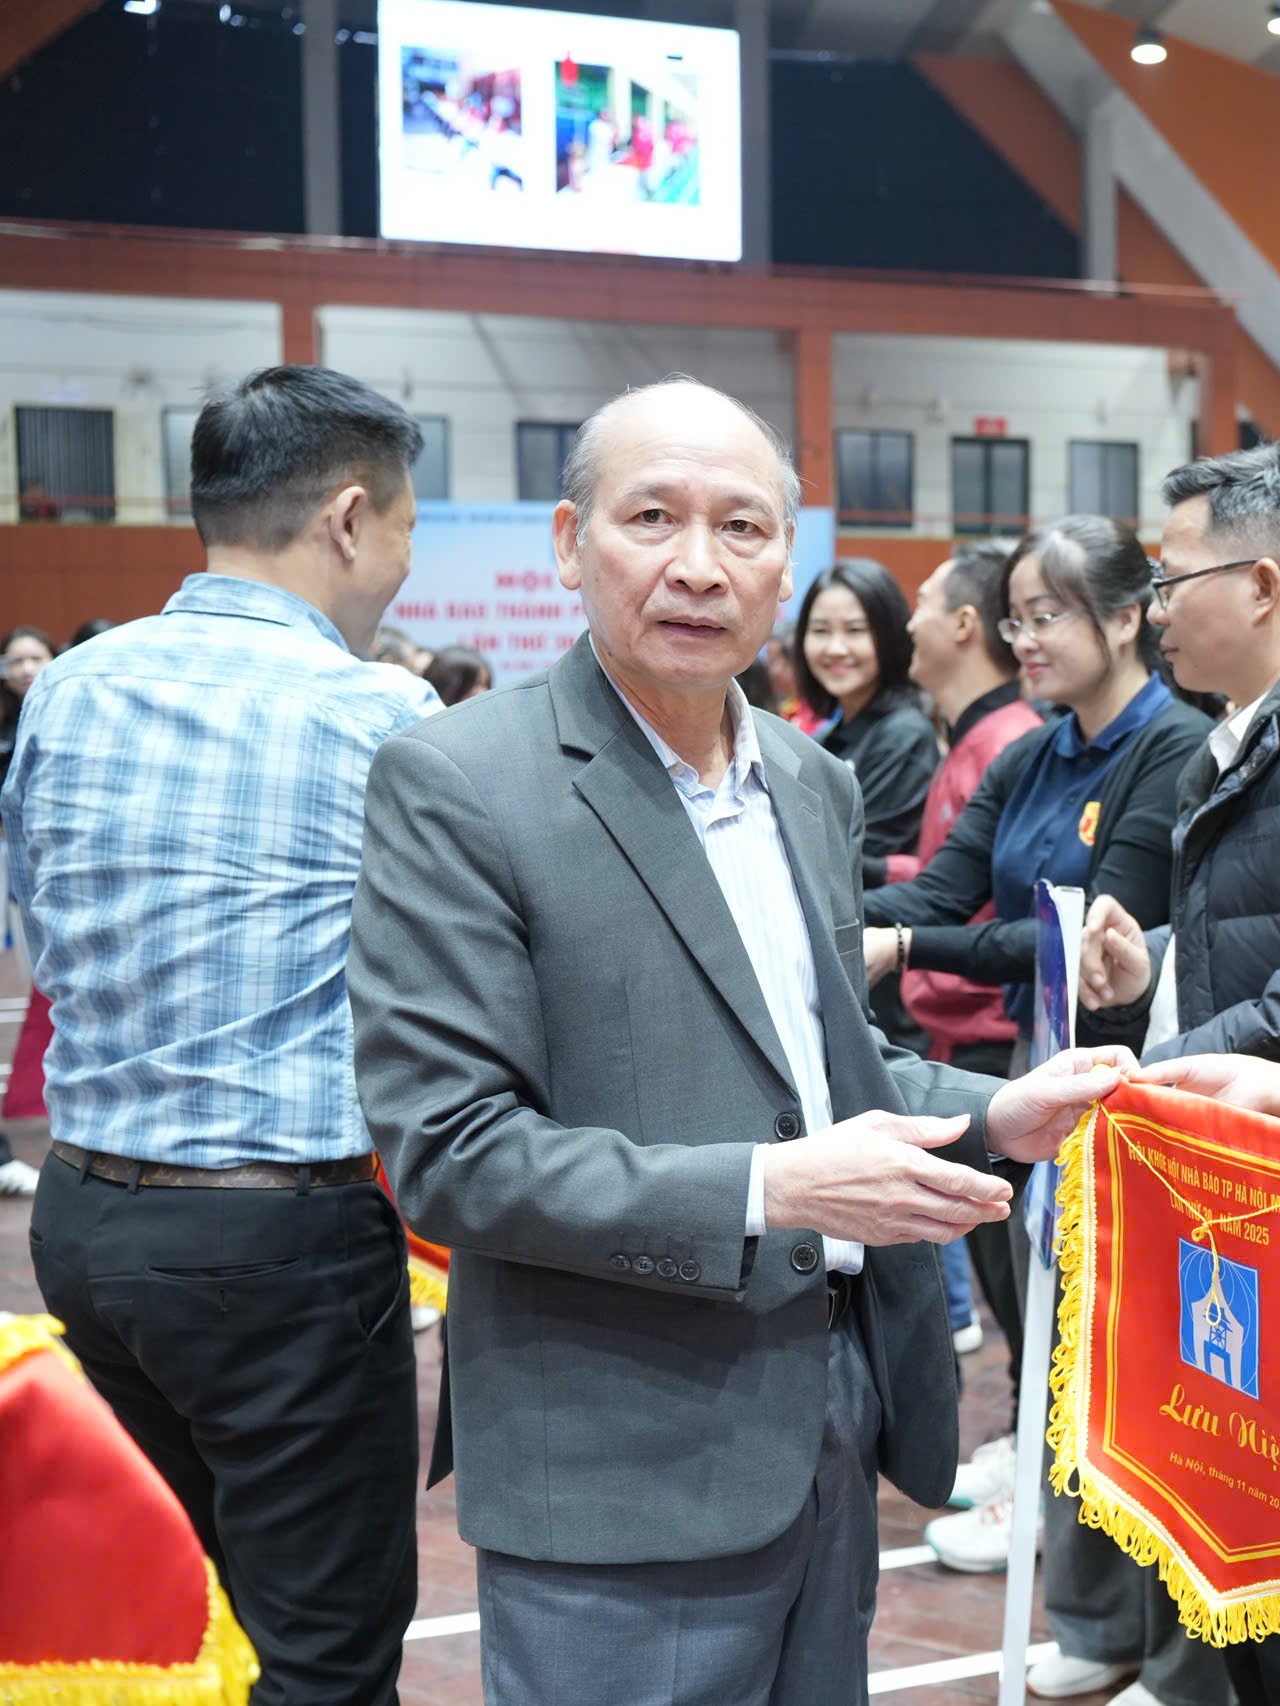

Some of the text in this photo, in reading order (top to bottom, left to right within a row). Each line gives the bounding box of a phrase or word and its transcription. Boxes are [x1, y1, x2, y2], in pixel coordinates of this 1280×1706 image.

[1181, 1165, 1200, 1188] NHÀ
[1203, 1170, 1220, 1195] BÁO
[1222, 1179, 1232, 1198] TP
[1235, 1182, 1247, 1205] HÀ
[1243, 1222, 1270, 1246] 2025
[1159, 1383, 1222, 1436] Lưu
[1169, 1451, 1183, 1466] Hà
[1208, 1467, 1235, 1488] tháng
[1236, 1480, 1246, 1491] 11
[1247, 1486, 1268, 1502] năm
